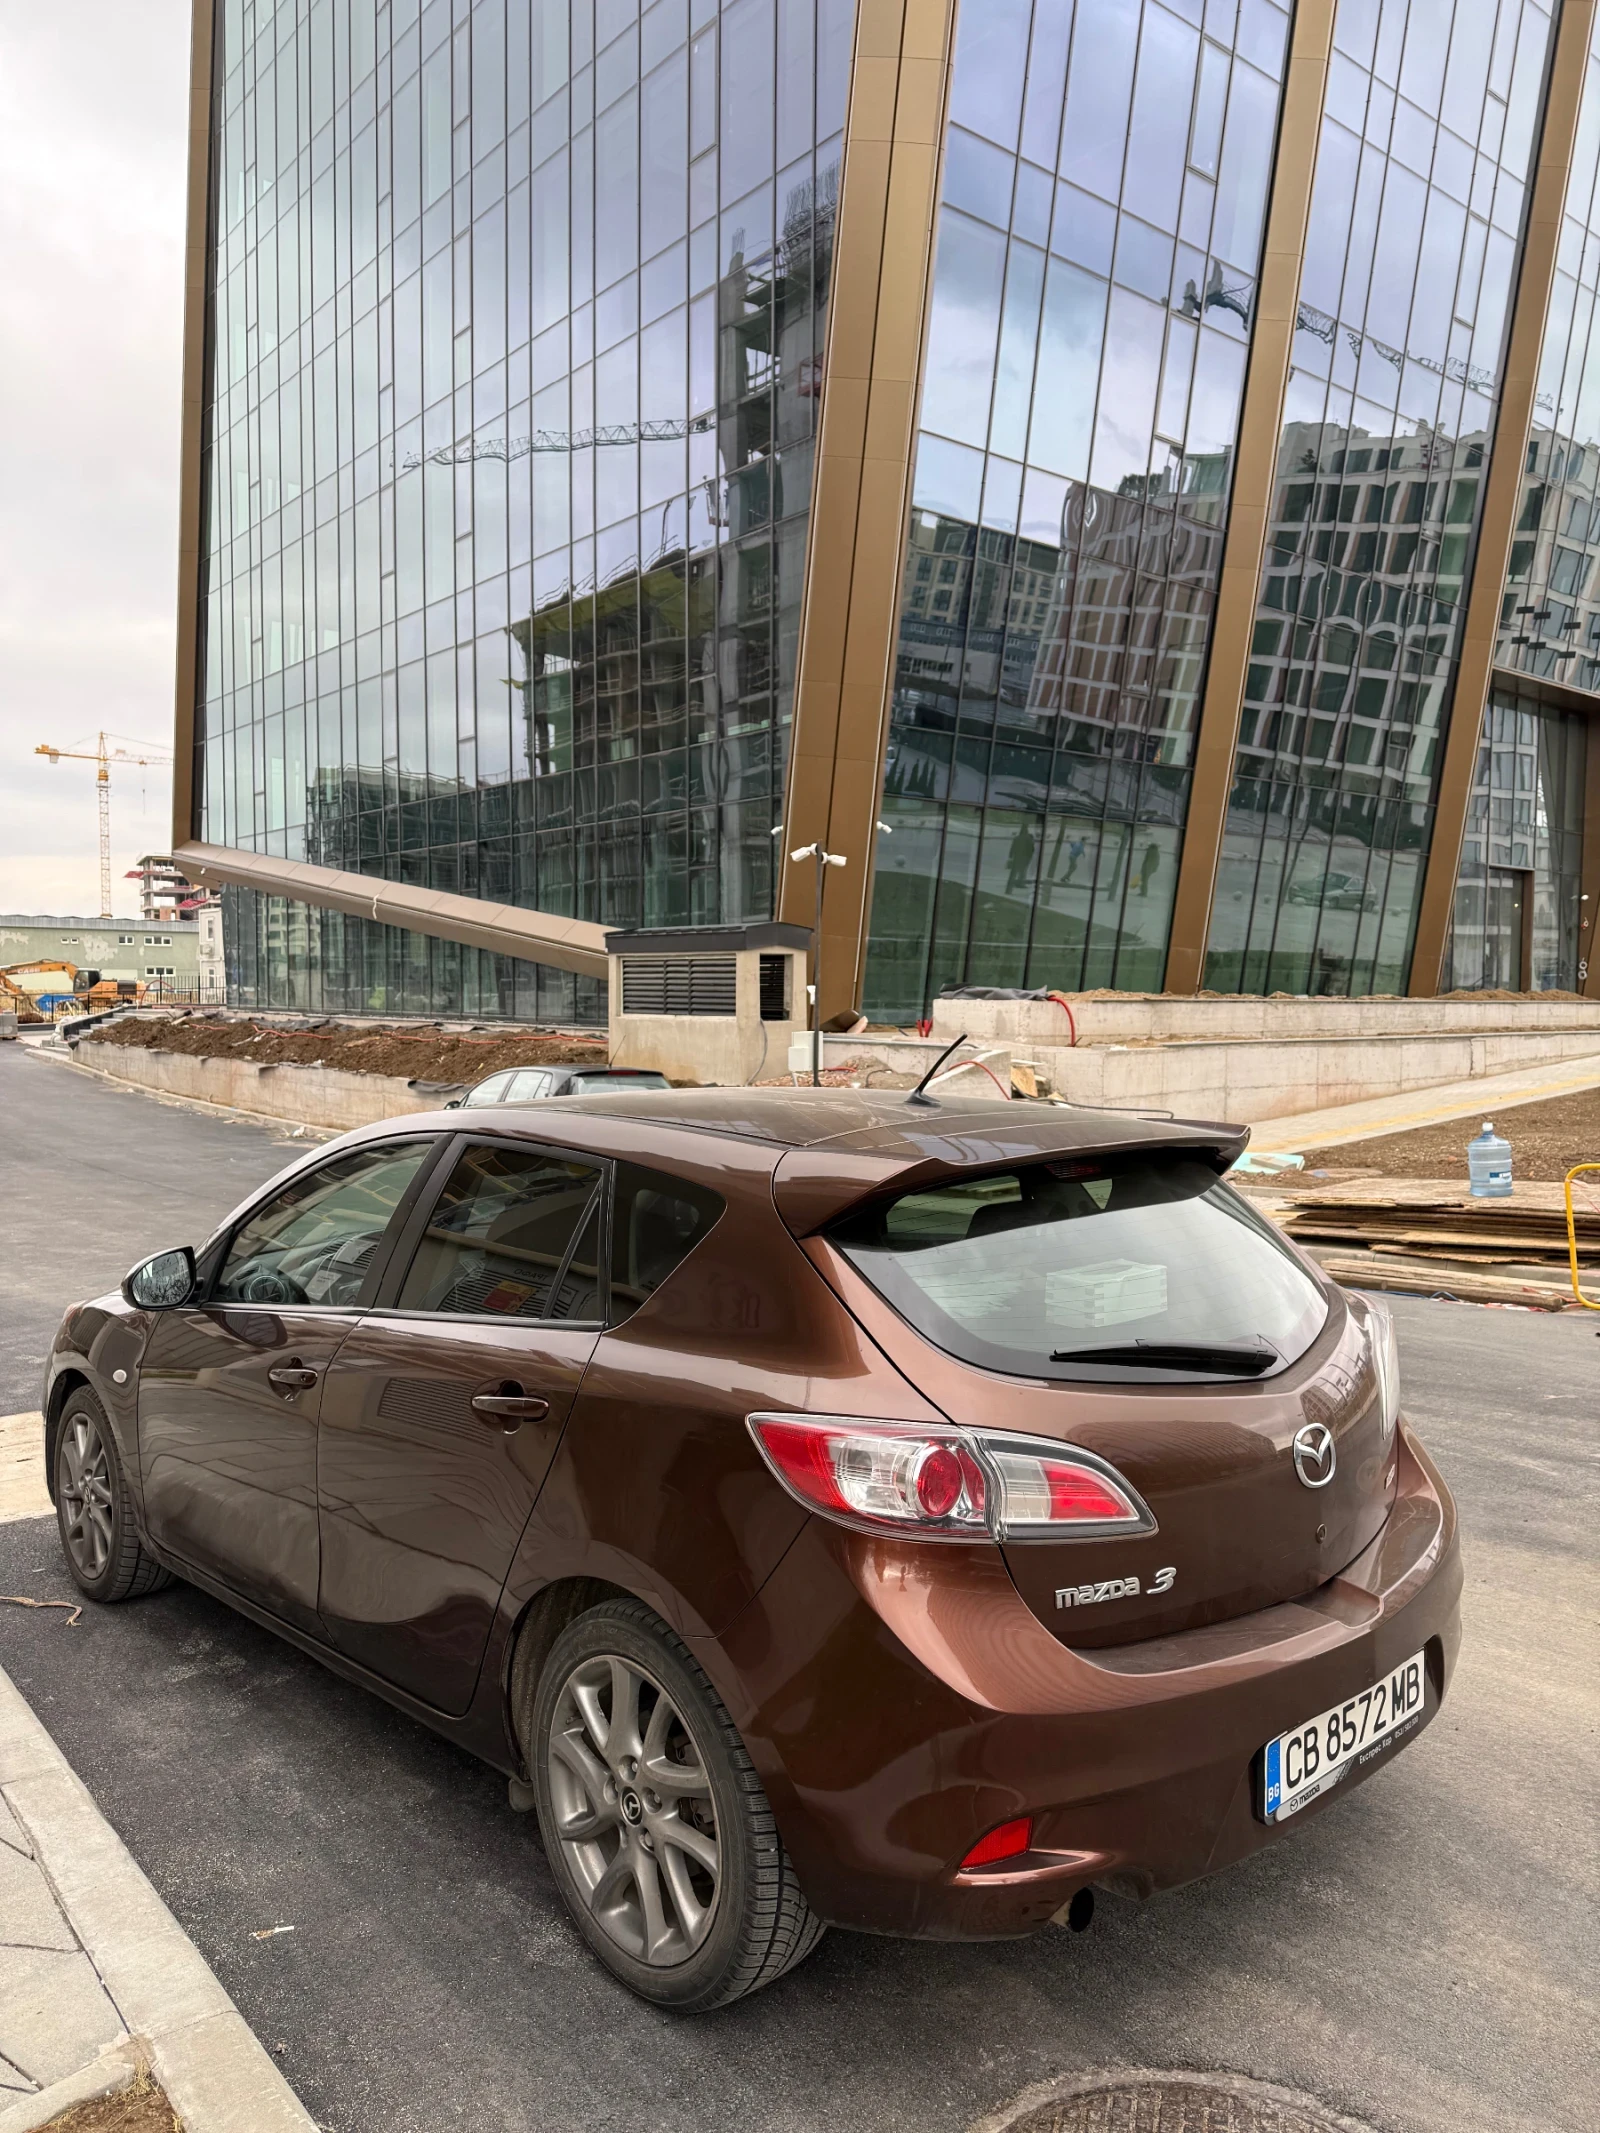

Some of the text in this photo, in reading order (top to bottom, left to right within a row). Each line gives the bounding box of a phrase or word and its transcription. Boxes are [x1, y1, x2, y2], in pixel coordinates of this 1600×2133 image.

[1055, 1567, 1177, 1609] mazda 3
[1286, 1662, 1420, 1788] CB 8572 MB
[1268, 1782, 1280, 1803] BG
[1299, 1784, 1320, 1804] mazda
